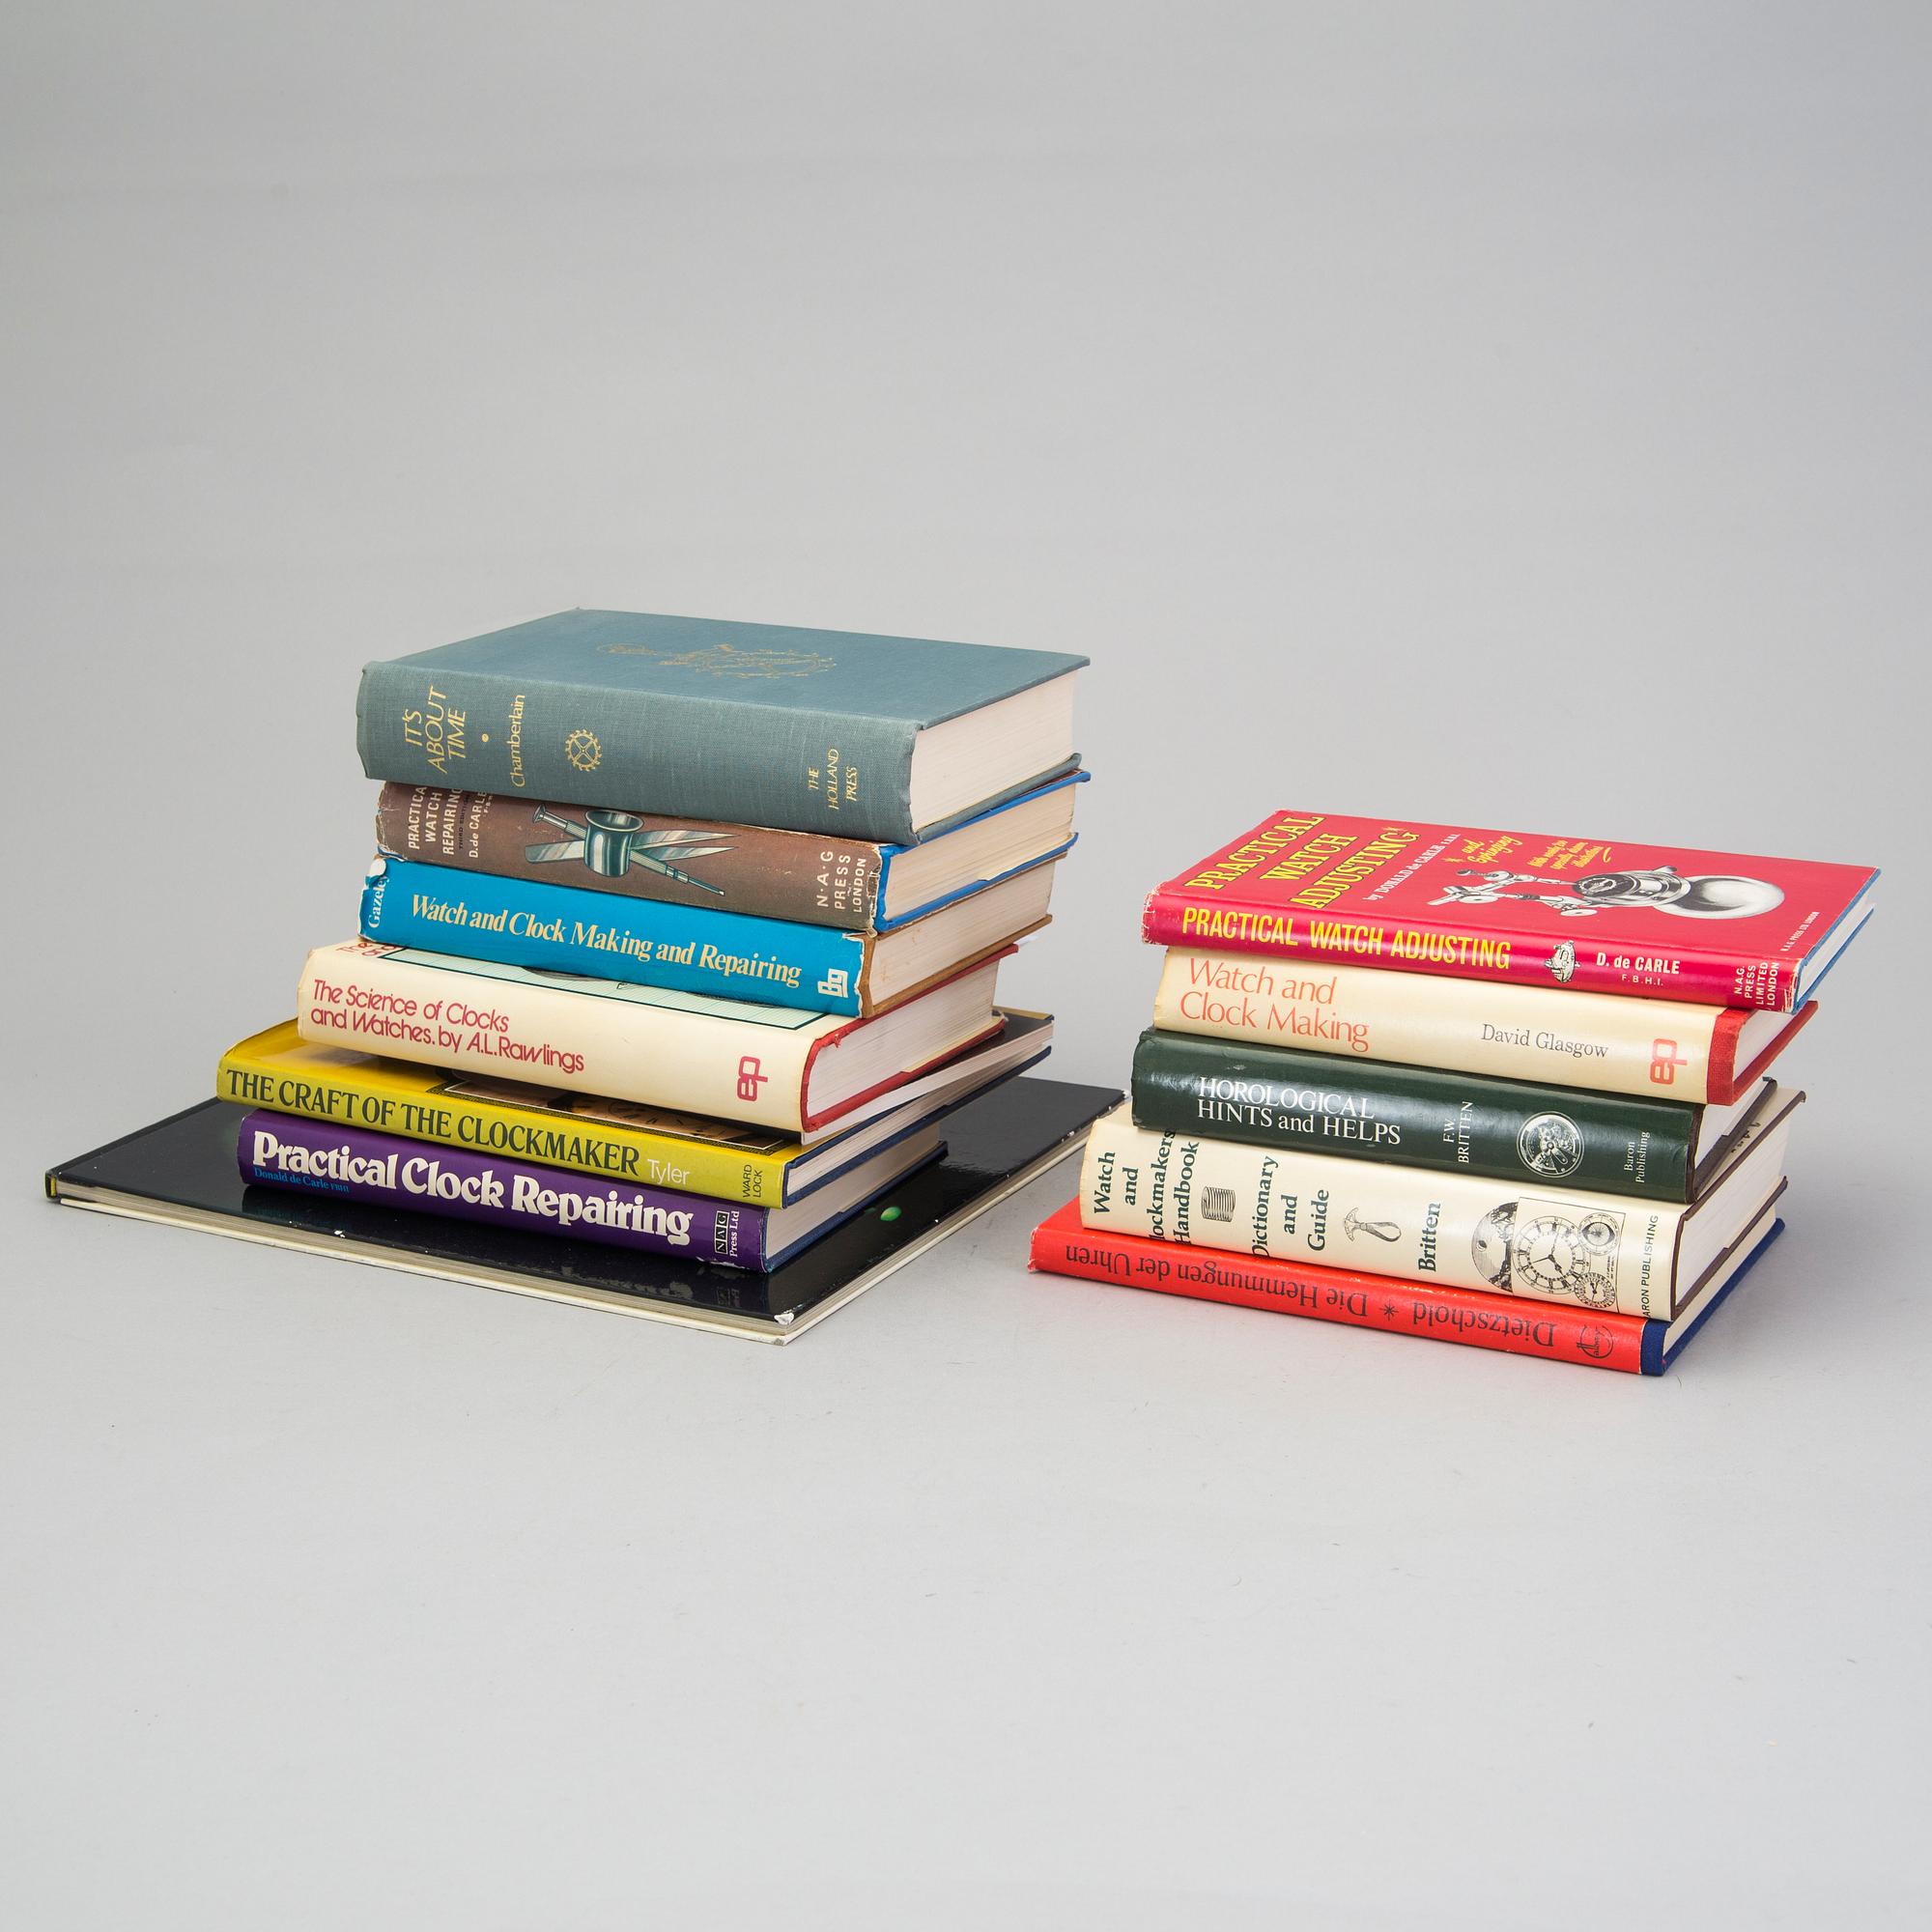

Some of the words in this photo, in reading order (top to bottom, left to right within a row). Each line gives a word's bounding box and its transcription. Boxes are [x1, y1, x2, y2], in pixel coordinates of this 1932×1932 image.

[401, 708, 422, 747] IT'S
[425, 685, 447, 775] ABOUT
[447, 710, 467, 759] TIME
[508, 695, 526, 788] Chamberlain
[808, 767, 819, 790] THE
[827, 749, 839, 810] HOLLAND
[845, 766, 857, 802] PRESS
[408, 785, 428, 850] PRACTICA
[424, 791, 443, 843] WATCH
[1184, 815, 1326, 891] PRACTICAL
[1259, 833, 1359, 881] WATCH
[1289, 831, 1421, 909] ADJUSTING
[1374, 869, 1414, 894] DONALD
[1413, 844, 1446, 864] CARLE
[834, 855, 851, 910] PRESS
[852, 858, 867, 913] LONDON
[412, 894, 469, 925] Watch
[469, 909, 508, 932] and
[508, 911, 566, 943] Clock
[569, 921, 652, 962] Making
[656, 940, 695, 965] and
[697, 943, 802, 989] Repairing
[1181, 907, 1298, 947] PRACTICAL
[1310, 921, 1382, 955] WATCH
[1391, 929, 1511, 970] ADJUSTING
[1189, 957, 1273, 996] Watch
[1281, 976, 1338, 1005] and
[1596, 952, 1610, 967] D.
[1613, 954, 1631, 969] de
[1634, 956, 1680, 975] CARLE
[1734, 966, 1746, 994] N.A.G.
[1744, 965, 1756, 999] PRESS
[1755, 962, 1769, 1005] LIMITED
[1767, 962, 1780, 1006] LONDON
[310, 1006, 349, 1030] and
[438, 1026, 463, 1054] by
[313, 979, 342, 1005] The
[345, 983, 418, 1018] Science
[422, 998, 444, 1020] of
[445, 1001, 510, 1034] Clocks
[1179, 991, 1258, 1029] Clock
[1266, 1004, 1371, 1053] Making
[1482, 1022, 1530, 1048] David
[1535, 1030, 1609, 1059] Glasgow
[1198, 1076, 1376, 1120] HOROLOGICAL
[226, 1068, 275, 1102] THE
[278, 1079, 360, 1120] CRAFT
[361, 1095, 397, 1126] OF
[400, 1103, 452, 1138] THE
[457, 1115, 640, 1177] CLOCKMAKER
[646, 1158, 691, 1186] Tyler
[1197, 1099, 1273, 1128] HINTS
[1278, 1113, 1315, 1134] and
[1321, 1116, 1402, 1146] HELPS
[1442, 1118, 1457, 1144] F.W.
[1458, 1100, 1474, 1164] BRITTEN
[254, 1168, 289, 1182] Donald
[289, 1174, 301, 1184] de
[302, 1176, 329, 1190] Carle
[1623, 1141, 1635, 1172] Baron
[1634, 1131, 1651, 1183] Publishing
[252, 1130, 399, 1191] Practical
[401, 1157, 505, 1209] Clock
[510, 1174, 695, 1246] Repairing
[743, 1164, 753, 1198] WARD
[753, 1169, 763, 1198] LOCK
[1094, 1151, 1116, 1213] Watch
[1122, 1167, 1139, 1207] and
[1147, 1129, 1177, 1240] lockmakers
[1173, 1142, 1200, 1245] Handbook
[729, 1210, 740, 1230] Ltd
[1251, 1155, 1279, 1259] Dictionary
[1280, 1193, 1298, 1236] and
[1307, 1189, 1330, 1252] Guide
[729, 1231, 739, 1258] Press
[1065, 1245, 1130, 1277] Uhren
[1417, 1202, 1442, 1274] Britten
[1641, 1214, 1660, 1287] PUBLISHING
[1136, 1258, 1171, 1277] der
[1179, 1262, 1318, 1308] Hemmungen
[1325, 1288, 1368, 1317] Die
[1412, 1301, 1555, 1349] Dietzschold
[1640, 1289, 1652, 1318] ARON
